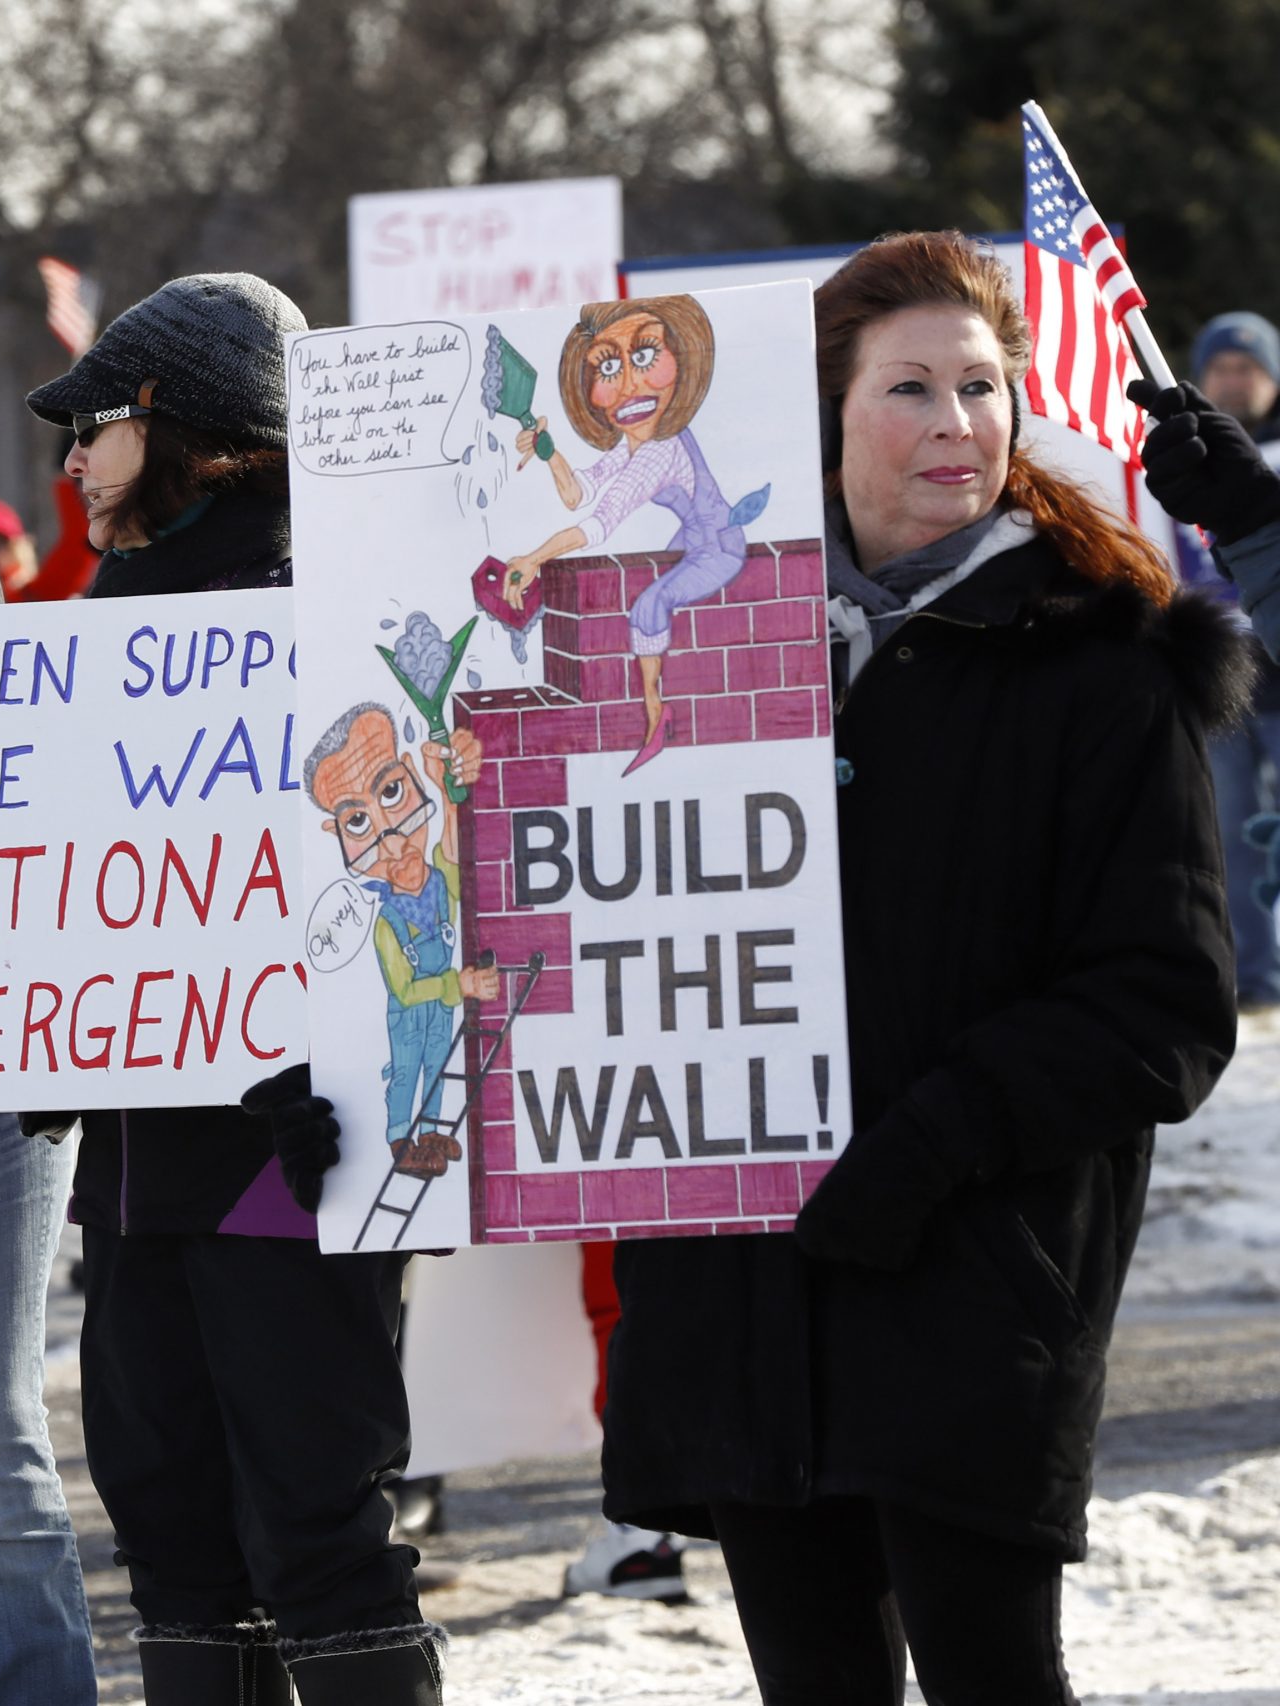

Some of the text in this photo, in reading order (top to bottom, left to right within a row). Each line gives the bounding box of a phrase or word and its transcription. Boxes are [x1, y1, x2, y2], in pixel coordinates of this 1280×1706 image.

[369, 208, 509, 268] STOP
[295, 334, 460, 389] You have to build
[313, 366, 424, 398] the Wall first
[297, 417, 417, 448] who is on the
[346, 403, 376, 435] you
[379, 399, 414, 412] can
[418, 392, 448, 406] see
[318, 448, 360, 468] other
[124, 626, 296, 696] SUPP
[512, 791, 807, 906] BUILD
[580, 928, 799, 1037] THE
[517, 1055, 833, 1163] WALL!
